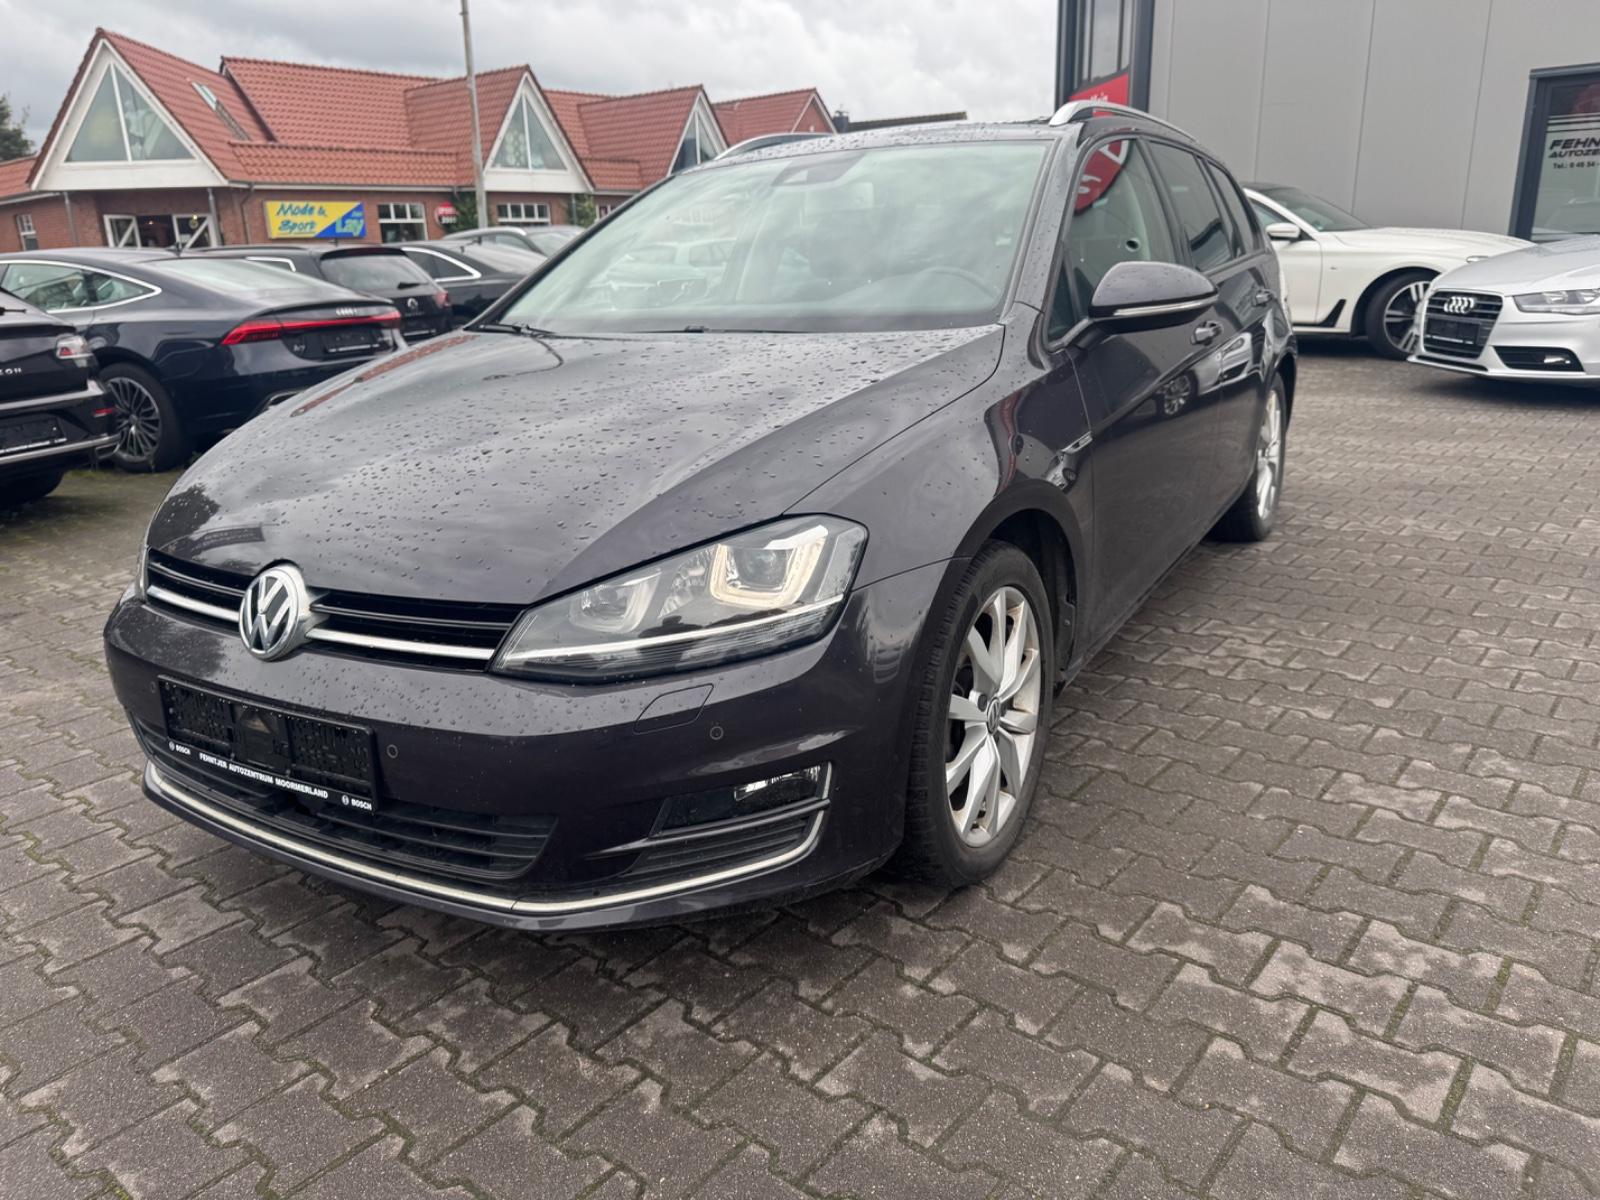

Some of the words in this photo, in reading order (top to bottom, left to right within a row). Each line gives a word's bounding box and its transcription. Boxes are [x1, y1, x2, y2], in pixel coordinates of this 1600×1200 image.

[276, 203, 314, 217] Mode
[278, 219, 316, 234] Sport
[175, 744, 191, 756] BOSCH
[228, 763, 274, 784] AUTOZENTRUM
[275, 778, 328, 799] MOORMERLAND
[351, 798, 373, 811] BOSCH
